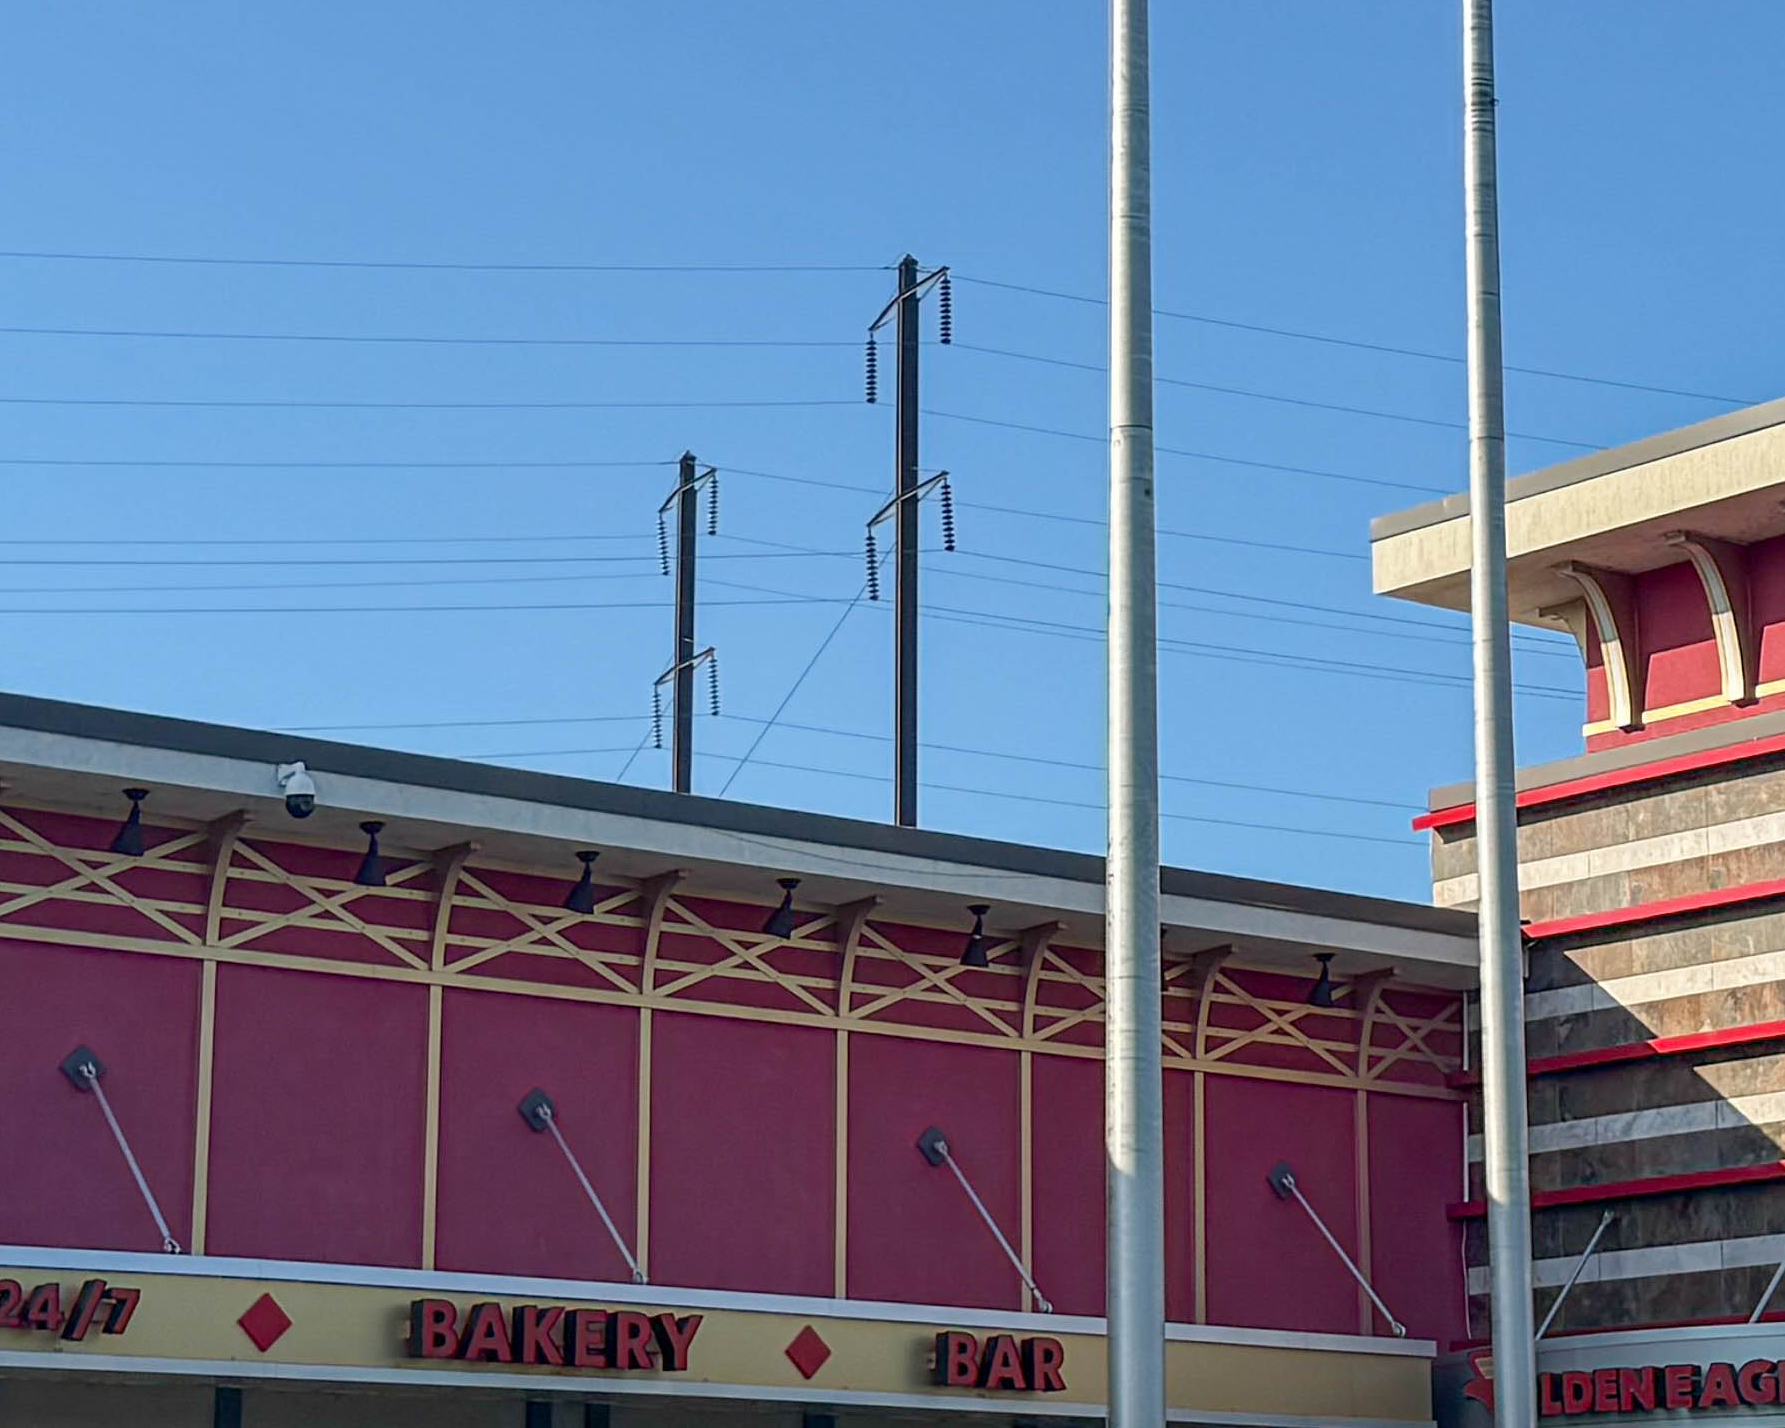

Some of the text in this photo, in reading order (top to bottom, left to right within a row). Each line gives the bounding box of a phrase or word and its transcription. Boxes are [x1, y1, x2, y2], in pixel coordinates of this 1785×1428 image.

[411, 1299, 703, 1371] BAKERY
[936, 1331, 1066, 1391] BAR
[1540, 1366, 1656, 1417] LDEN
